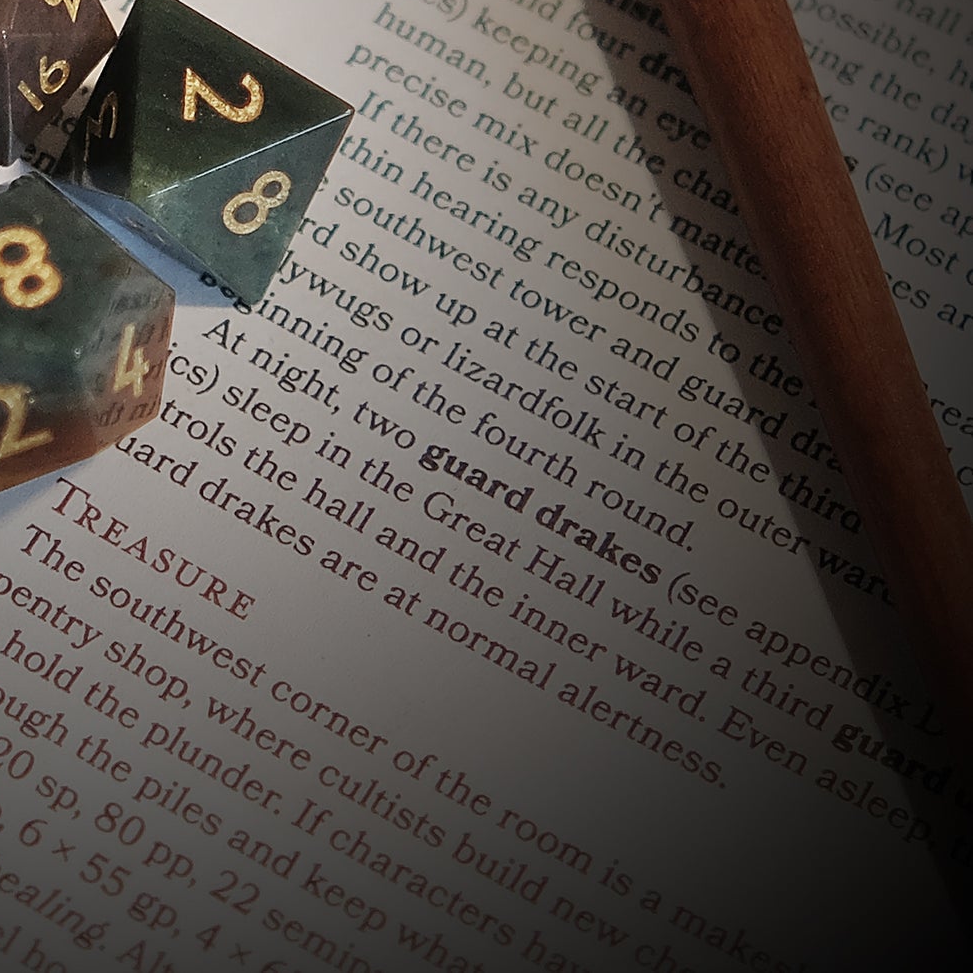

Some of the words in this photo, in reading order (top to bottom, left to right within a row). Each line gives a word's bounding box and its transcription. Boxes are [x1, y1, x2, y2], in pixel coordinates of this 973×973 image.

[182, 66, 265, 123] 2
[345, 44, 468, 117] precise
[372, 1, 492, 88] human,
[473, 7, 603, 96] keeping
[222, 170, 292, 236] 8
[333, 186, 506, 291] southwest
[508, 277, 608, 344] tower
[390, 113, 477, 173] there
[584, 218, 787, 342] disturbance
[408, 170, 544, 264] hearing
[543, 250, 701, 344] responds
[864, 162, 934, 213] (see
[872, 210, 960, 276] Most
[440, 341, 608, 451] lizardfolk
[716, 497, 817, 556] outer
[583, 374, 669, 431] start
[247, 346, 341, 416] night,
[352, 400, 417, 451] two
[416, 443, 536, 515] guard
[534, 503, 663, 586] drakes
[666, 571, 740, 628] (see
[743, 619, 918, 729] appendix
[469, 411, 579, 490] fourth
[582, 479, 696, 553] round.
[422, 490, 523, 564] Great
[521, 543, 607, 609] Hall
[739, 666, 836, 733] third
[507, 600, 609, 664] inner
[614, 653, 709, 724] ward.
[715, 704, 809, 778] Even
[19, 522, 86, 583] The
[88, 575, 268, 689] southwest
[270, 680, 390, 756] corner
[433, 768, 493, 817] the
[495, 808, 594, 876] room
[102, 639, 193, 710] shop,
[206, 695, 312, 772] where
[317, 764, 447, 849] cultists
[421, 607, 558, 692] normal
[556, 682, 727, 791] alertness.
[34, 774, 82, 821] sp,
[208, 868, 262, 917] 22
[78, 851, 132, 897] 55
[131, 775, 223, 837] piles
[300, 862, 388, 932] keep
[138, 721, 283, 816] plunder.
[328, 828, 517, 947] characters
